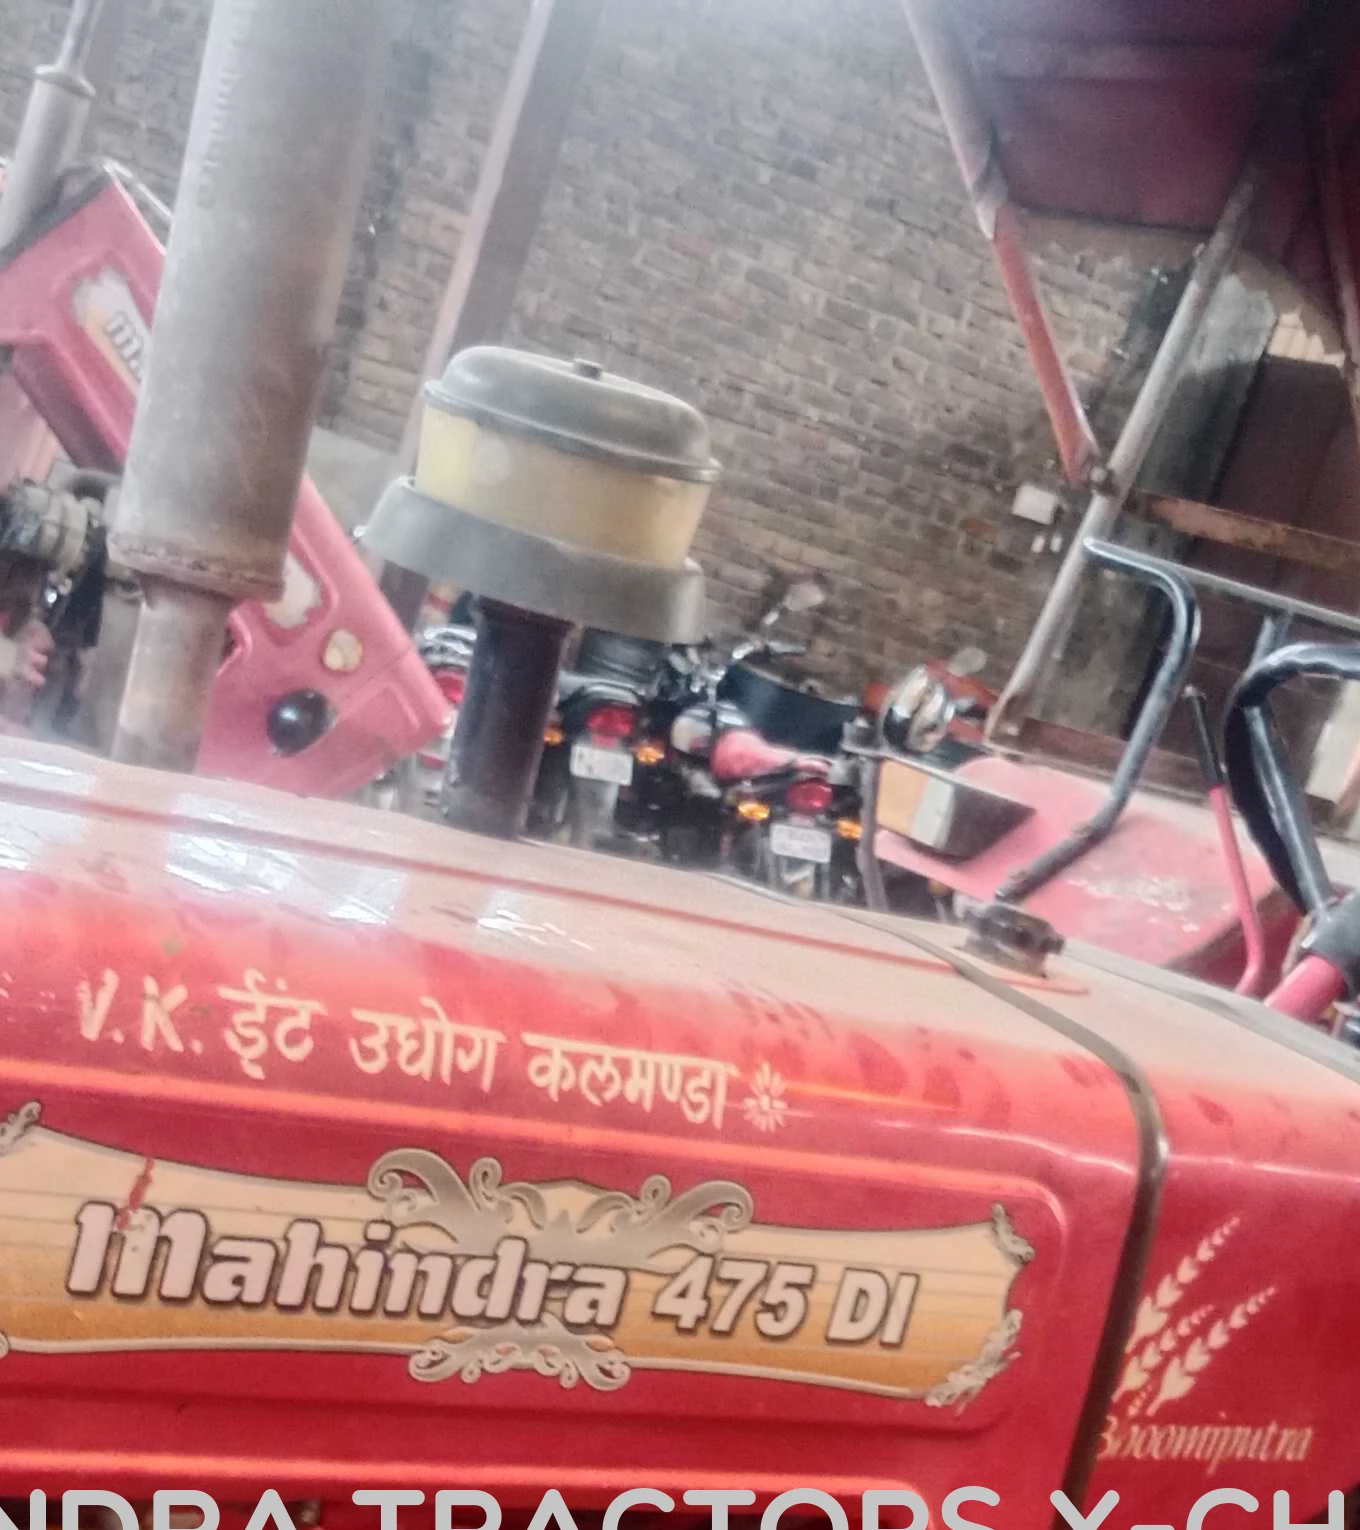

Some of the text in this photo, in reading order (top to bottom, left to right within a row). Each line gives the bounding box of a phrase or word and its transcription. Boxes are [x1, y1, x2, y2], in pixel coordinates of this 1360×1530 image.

[65, 1199, 921, 1348] Mahindra 475 DI
